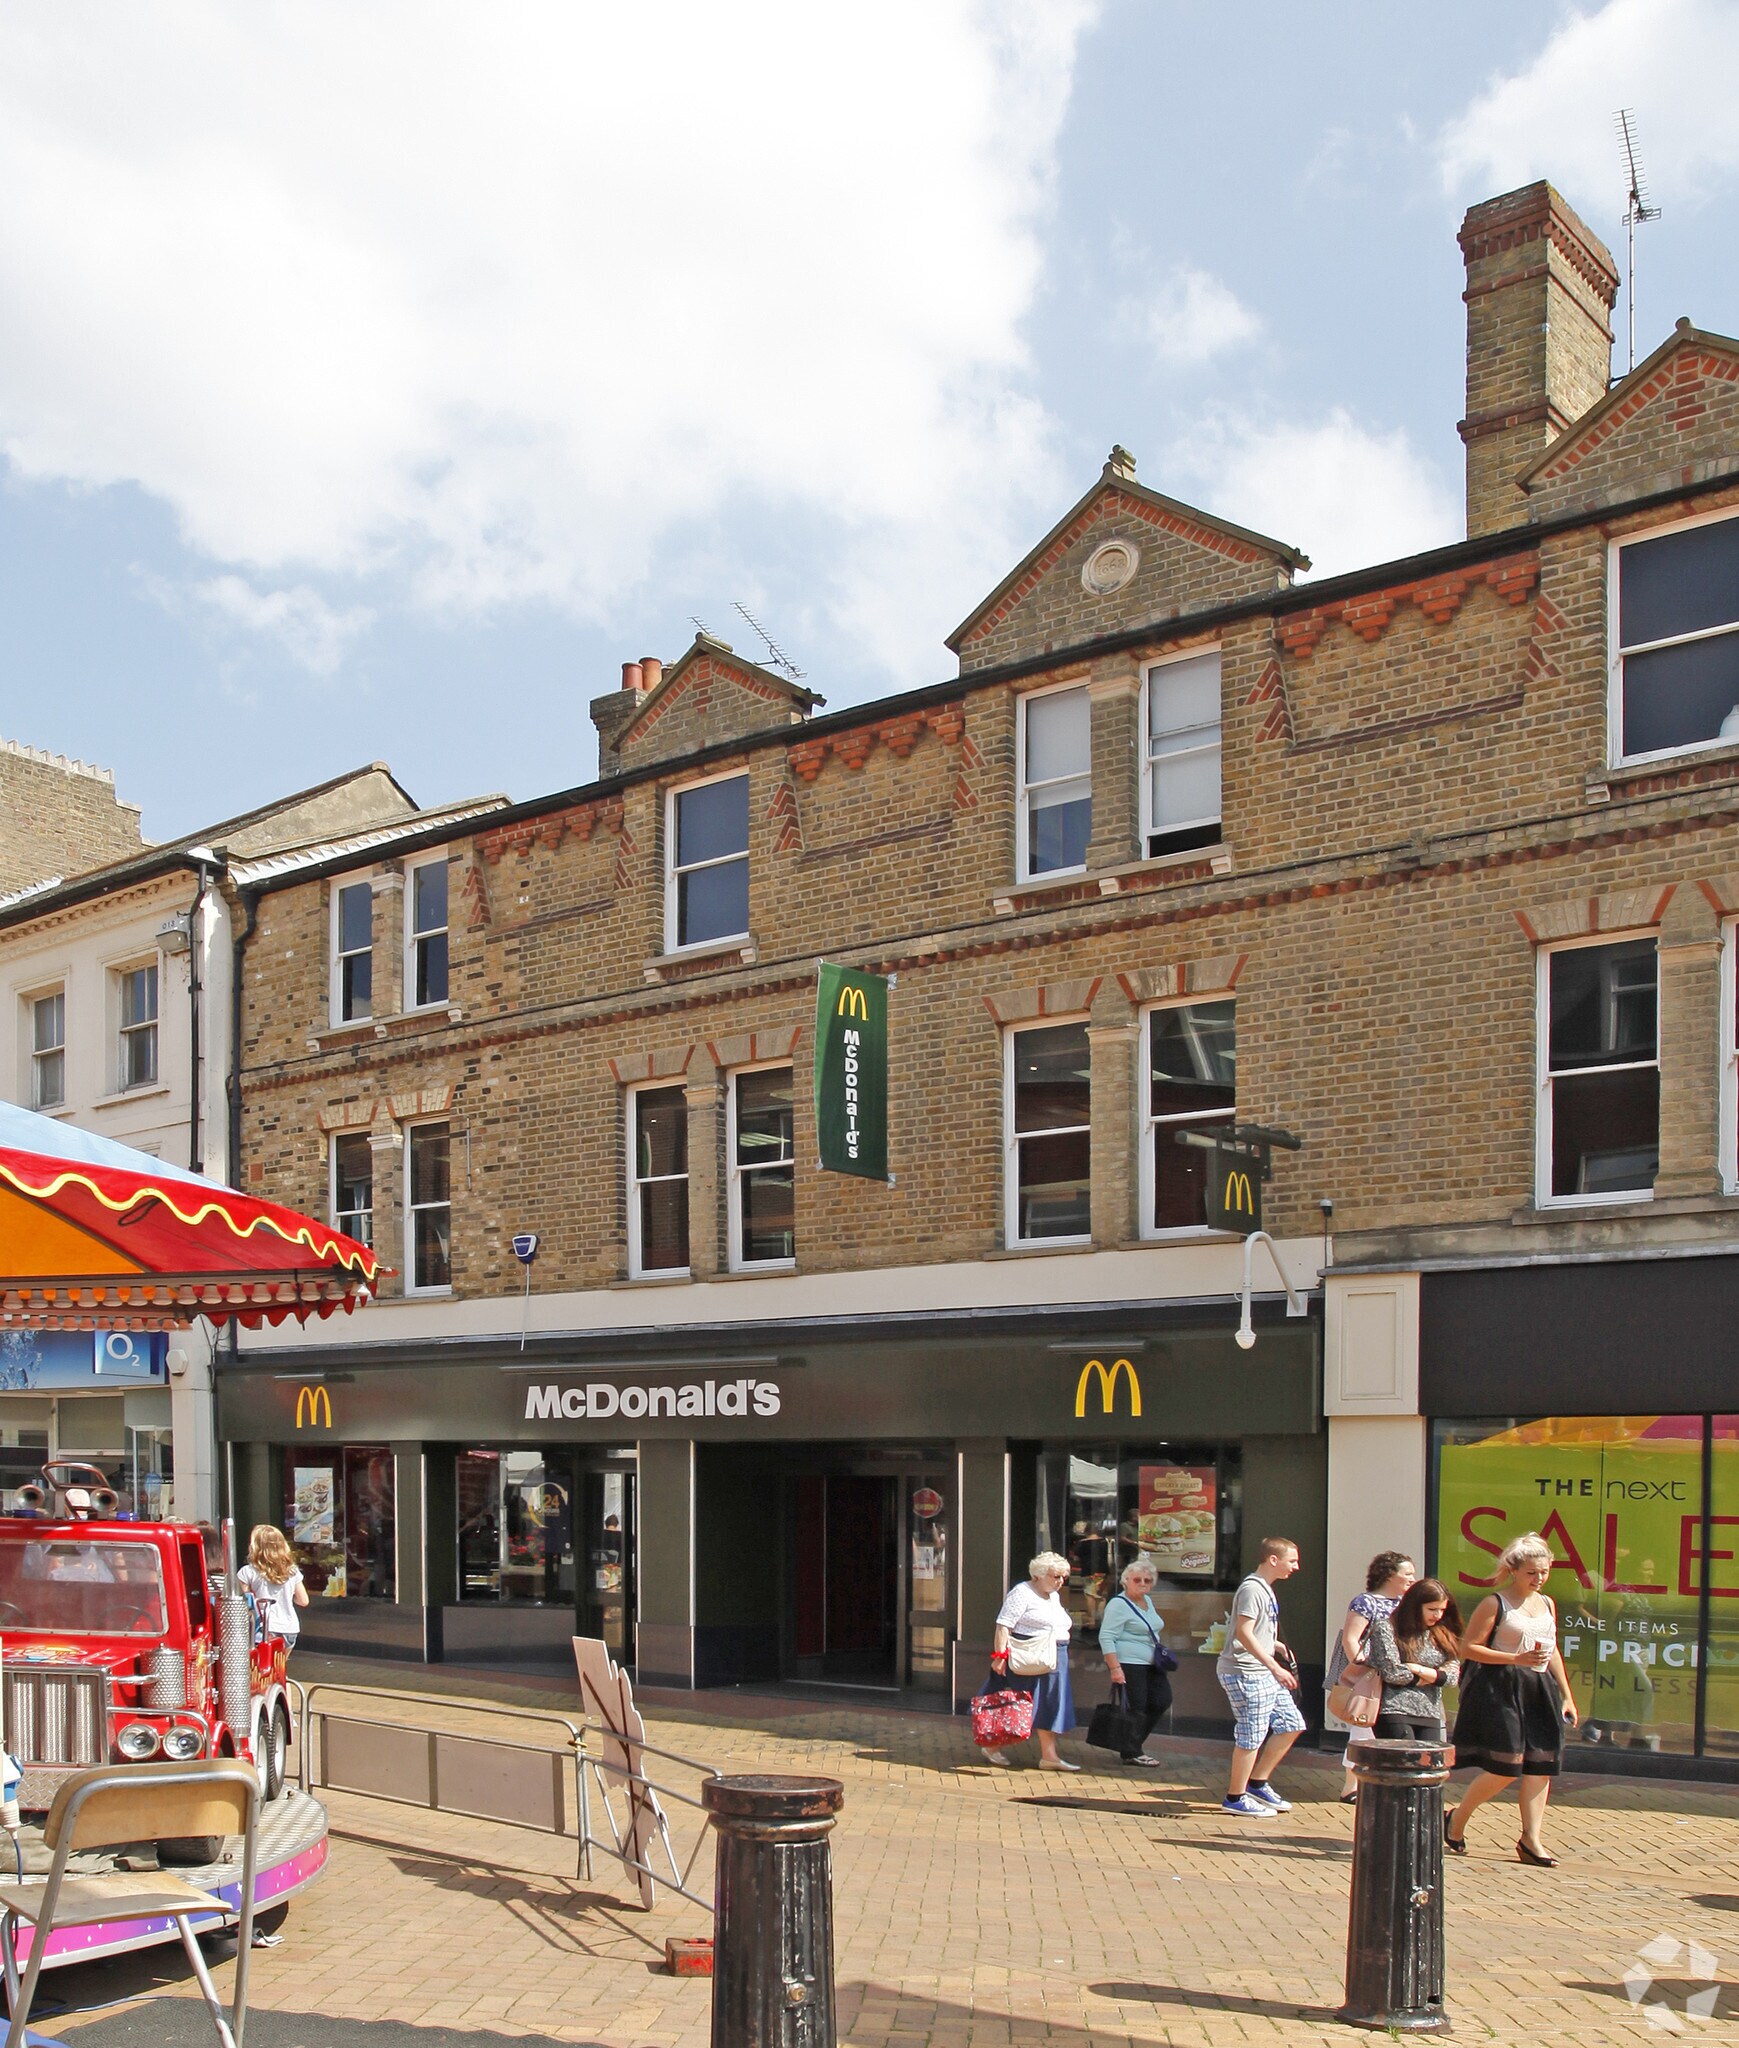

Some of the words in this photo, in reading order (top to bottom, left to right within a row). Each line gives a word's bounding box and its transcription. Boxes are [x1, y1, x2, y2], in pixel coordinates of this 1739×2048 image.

[844, 1029, 860, 1159] McDonald's
[525, 1379, 781, 1419] McDonald's
[1535, 1478, 1593, 1496] THE
[1606, 1480, 1686, 1501] next
[1458, 1506, 1739, 1597] SALE
[1565, 1615, 1606, 1631] SALE
[1618, 1620, 1679, 1635] ITEMS
[1634, 1676, 1698, 1696] LESS
